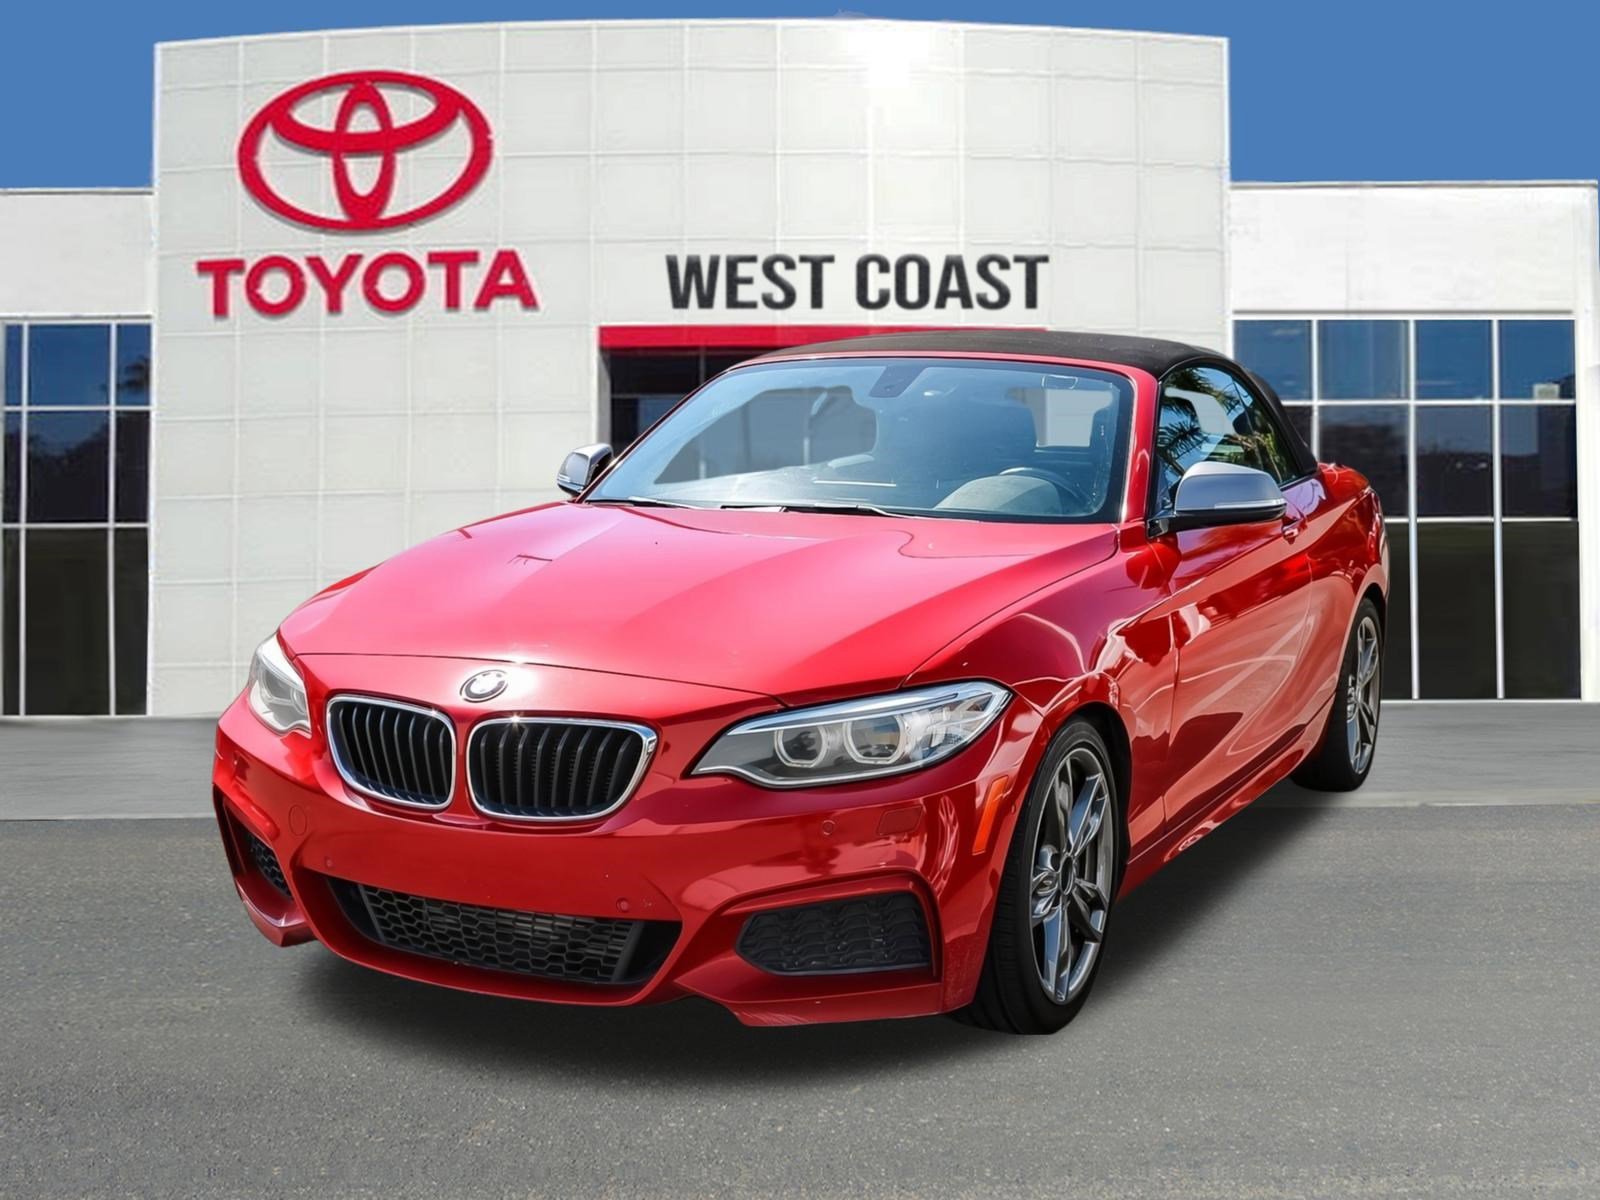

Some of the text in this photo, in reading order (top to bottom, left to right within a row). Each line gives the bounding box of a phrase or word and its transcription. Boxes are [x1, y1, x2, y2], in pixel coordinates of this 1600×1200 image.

[196, 249, 538, 317] TOYOTA
[666, 255, 1049, 310] WEST COAST
